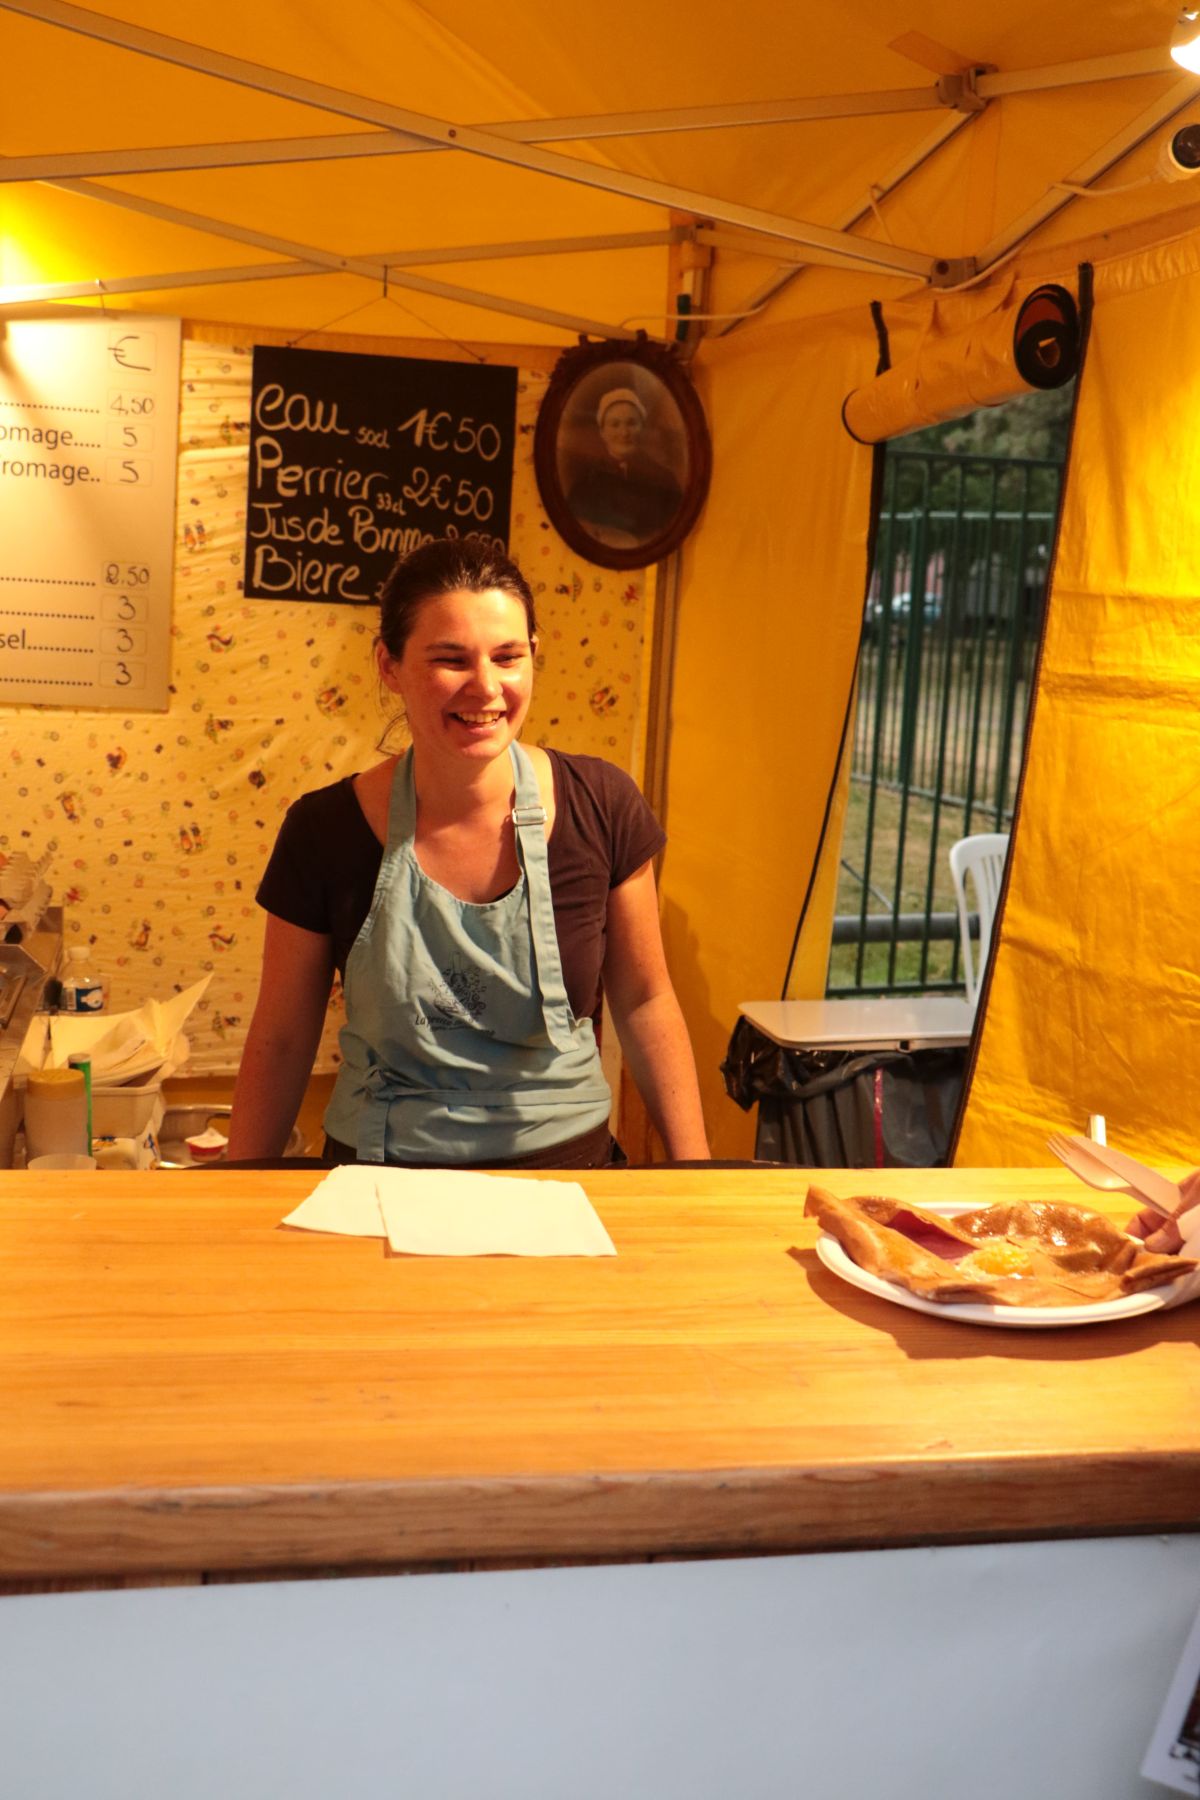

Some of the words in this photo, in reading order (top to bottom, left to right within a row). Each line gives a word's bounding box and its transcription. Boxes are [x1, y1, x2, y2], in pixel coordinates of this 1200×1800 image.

[122, 426, 138, 448] 5
[119, 460, 140, 484] 5
[254, 436, 389, 501] Perrier
[117, 595, 137, 621] 3
[116, 628, 135, 653] 3
[115, 661, 133, 686] 3
